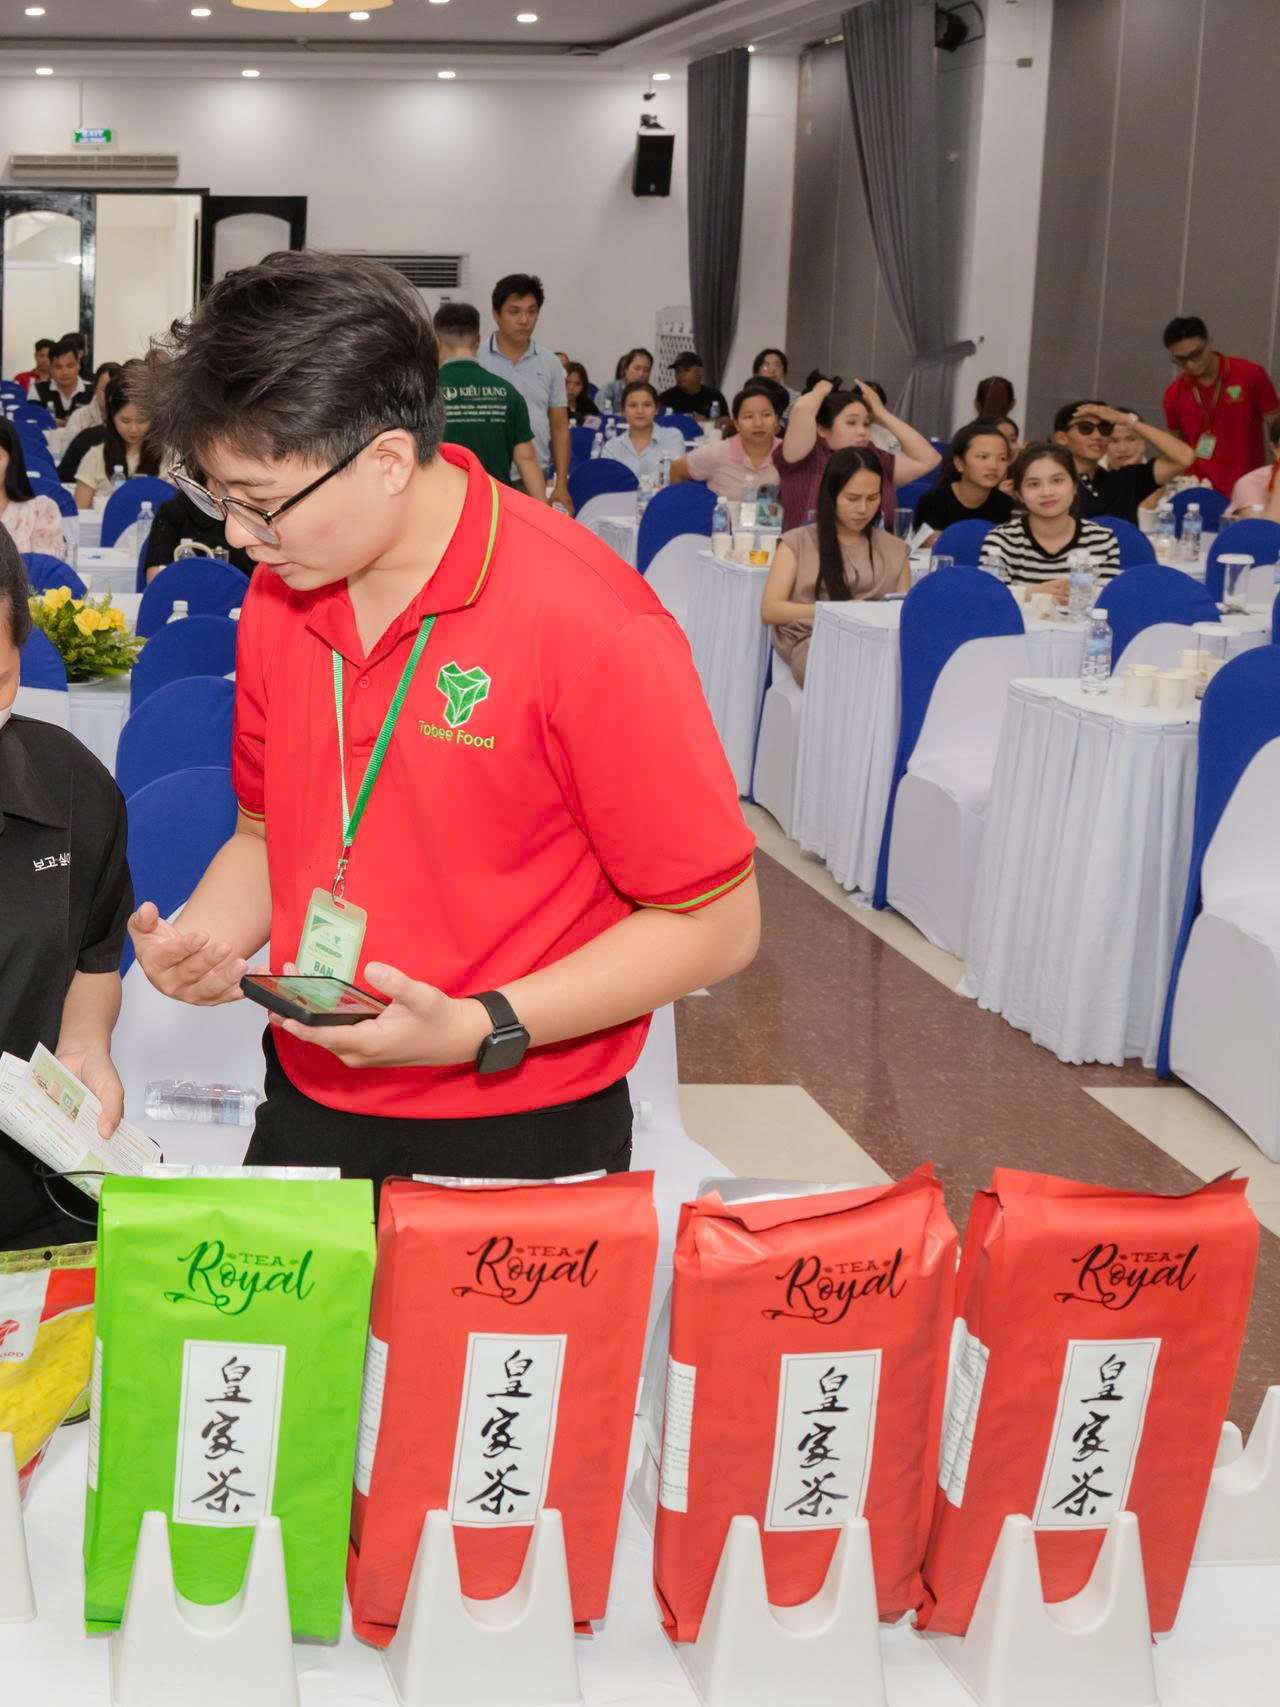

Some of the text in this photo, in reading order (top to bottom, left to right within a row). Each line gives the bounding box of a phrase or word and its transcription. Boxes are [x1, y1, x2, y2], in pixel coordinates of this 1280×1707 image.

[418, 719, 495, 749] Tobee Food
[164, 1240, 317, 1316] Royal
[240, 1253, 284, 1266] TEA
[452, 1236, 599, 1305] Royal
[528, 1246, 570, 1257] TEA
[761, 1247, 908, 1325] Royal
[836, 1259, 879, 1274] TEA
[1054, 1243, 1200, 1311] Royal
[1131, 1252, 1172, 1263] TEA
[192, 1356, 256, 1513] 皇家茶
[467, 1350, 534, 1515] 皇家茶
[784, 1367, 849, 1517] 皇家茶
[1052, 1354, 1126, 1517] 皇家茶
